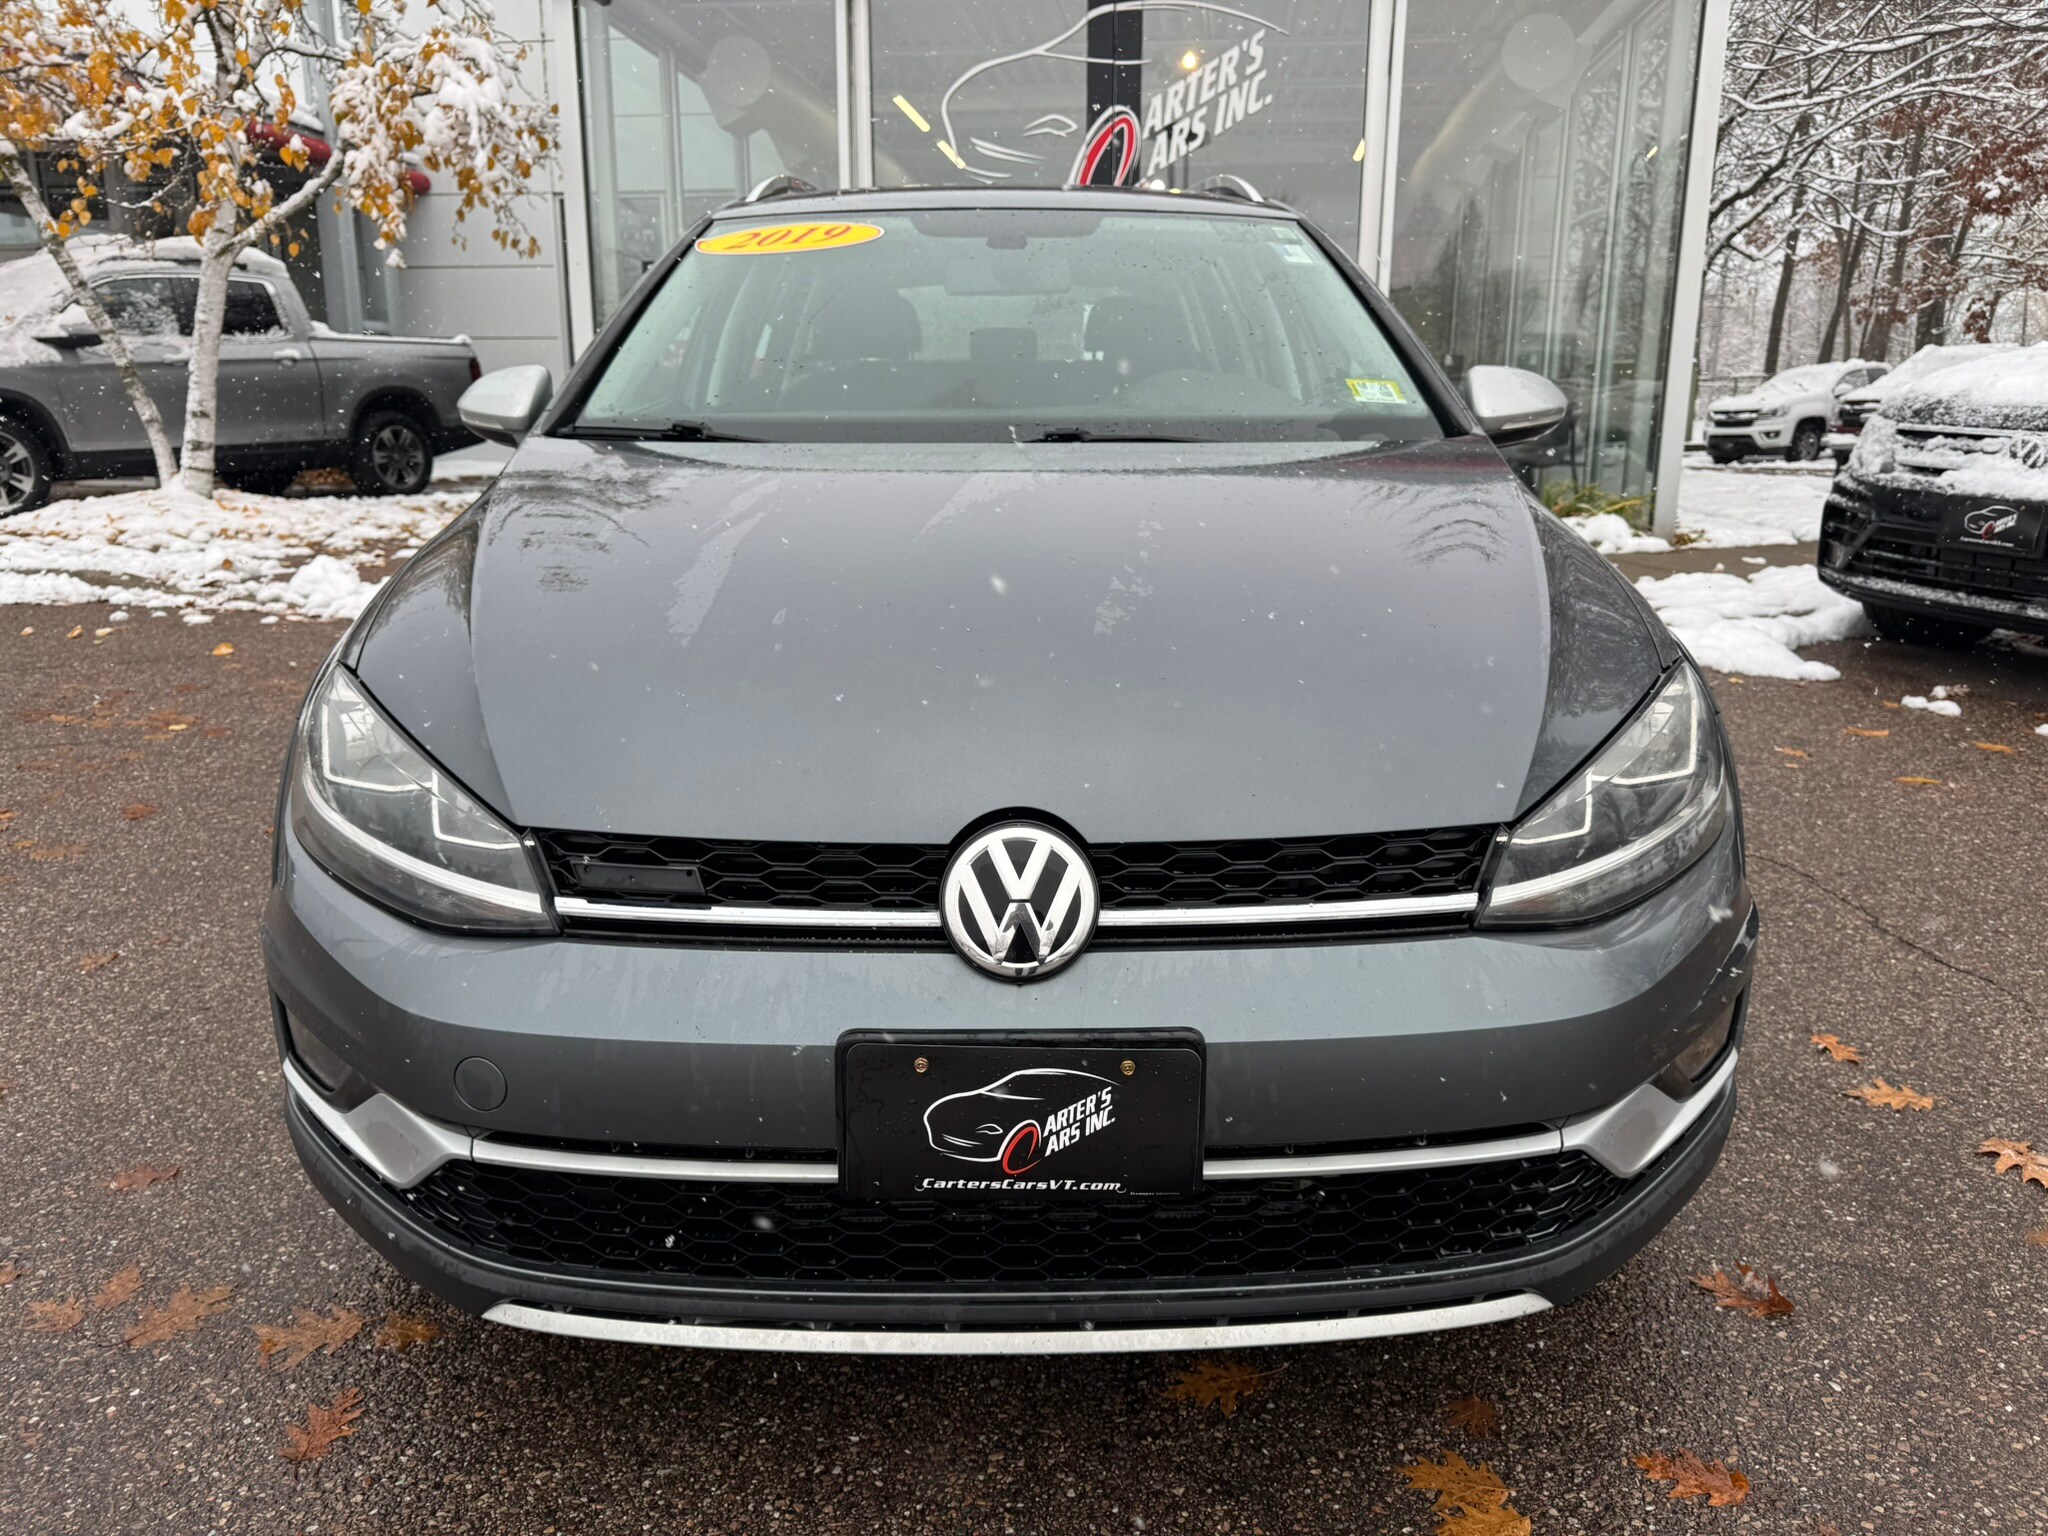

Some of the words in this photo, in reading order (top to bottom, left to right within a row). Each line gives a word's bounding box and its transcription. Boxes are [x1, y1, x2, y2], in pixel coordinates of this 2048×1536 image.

[1214, 69, 1273, 136] INC.
[722, 225, 852, 250] 2019
[1085, 1105, 1116, 1137] INC.
[919, 1177, 1124, 1192] CartersCarsVT.com
